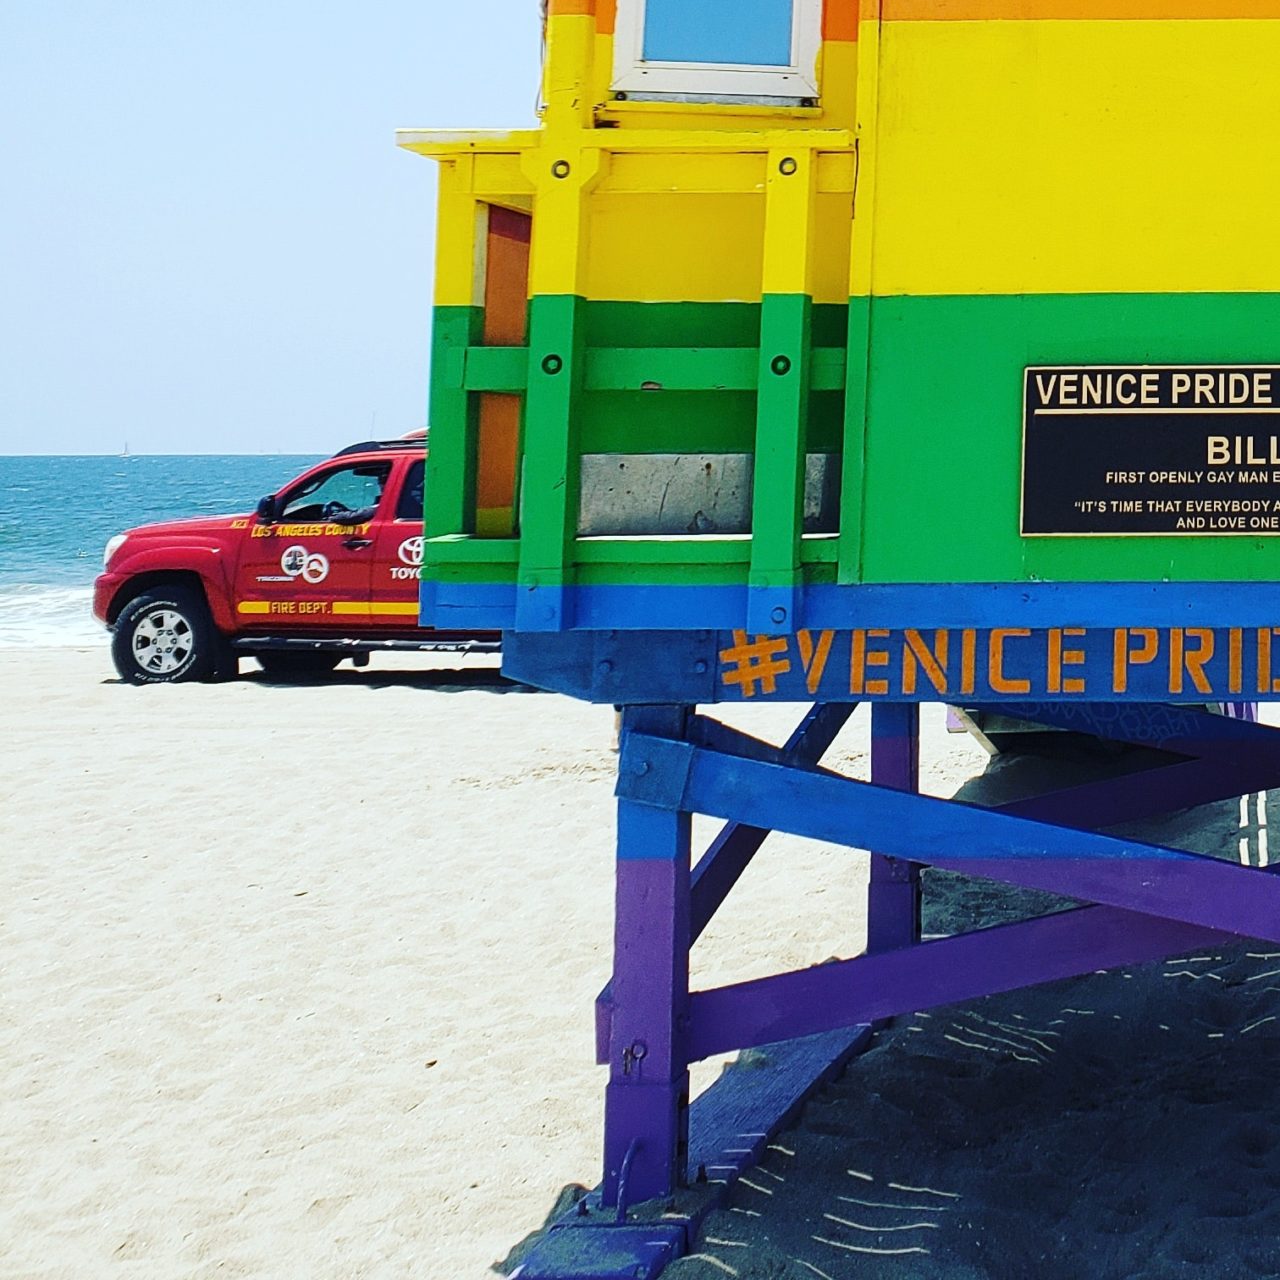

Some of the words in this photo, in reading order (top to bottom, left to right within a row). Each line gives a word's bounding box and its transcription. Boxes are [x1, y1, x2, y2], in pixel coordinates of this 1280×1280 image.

[1035, 373, 1160, 405] VENICE
[1171, 372, 1273, 404] PRIDE
[1105, 471, 1146, 484] FIRST
[1148, 471, 1204, 484] OPENLY
[1206, 470, 1235, 484] GAY
[1238, 470, 1269, 484] MAN
[1074, 500, 1107, 513] "IT'S
[1110, 500, 1143, 513] TIME
[1146, 500, 1183, 513] THAT
[1185, 499, 1271, 513] EVERYBODY
[1176, 516, 1206, 529] AND
[1209, 516, 1246, 529] LOVE
[1249, 516, 1280, 529] ONE
[251, 524, 272, 538] LOS
[276, 524, 322, 536] ANGELES
[325, 524, 370, 536] COUNTY
[271, 602, 295, 614] FIRE
[299, 602, 332, 614] DEPT.
[720, 628, 1086, 696] #VENICE
